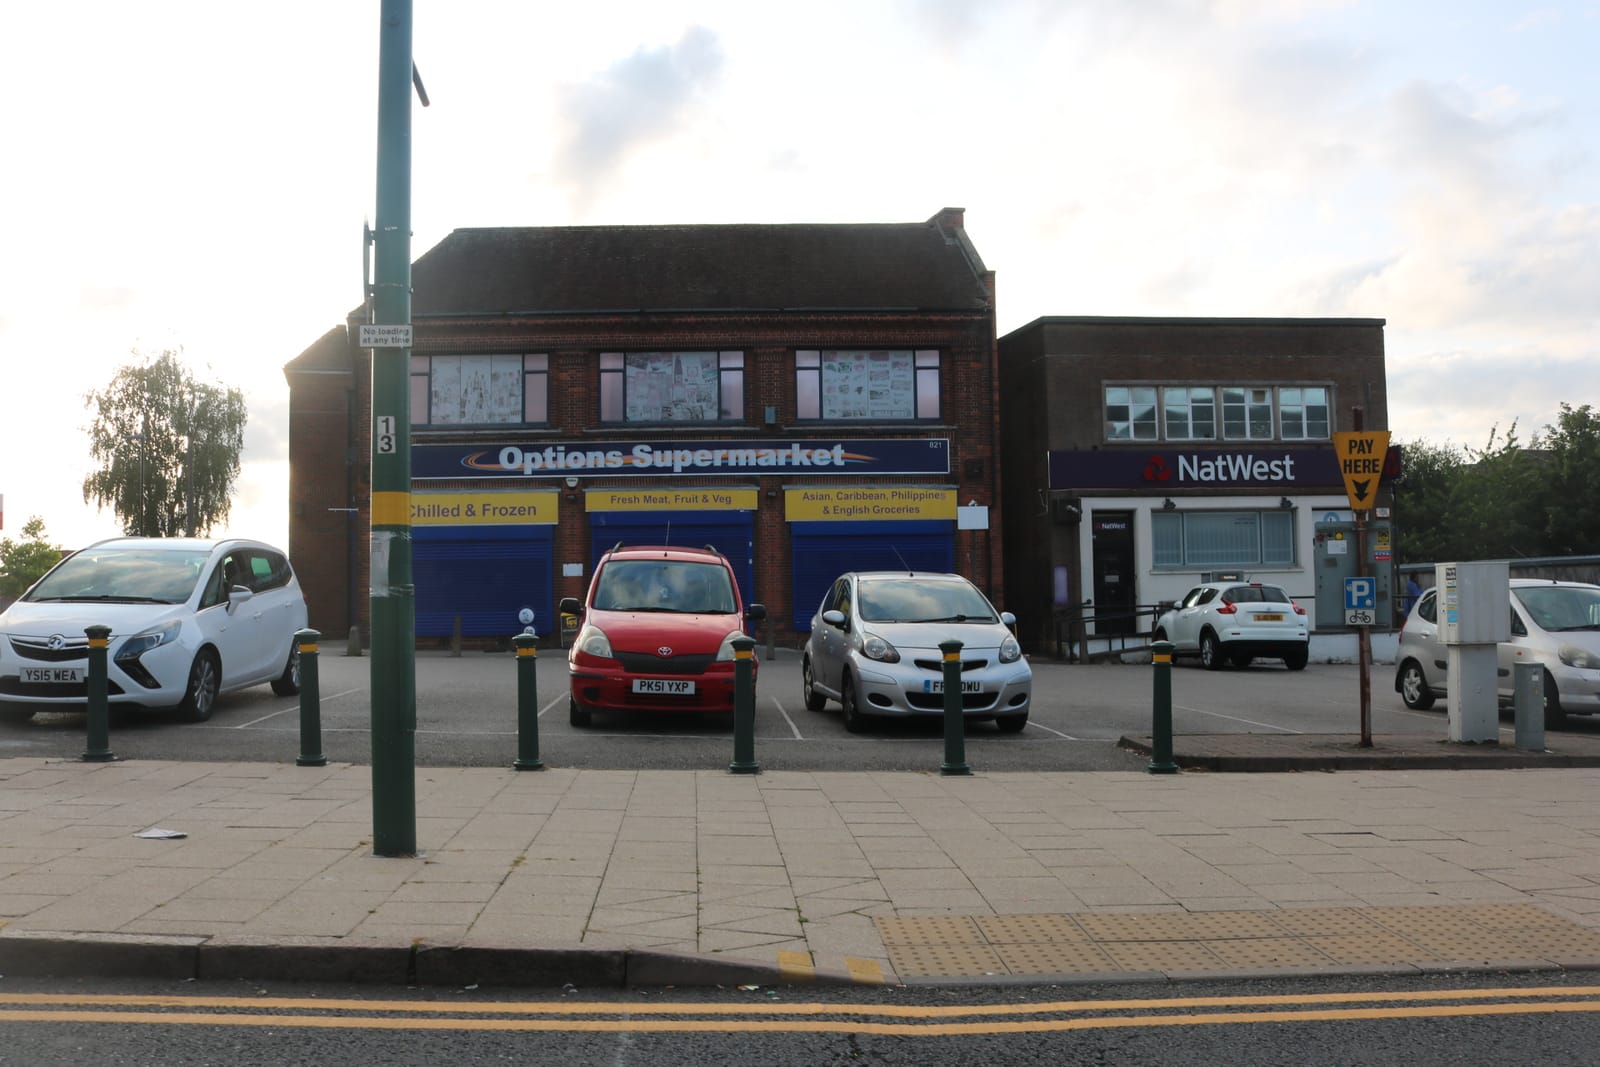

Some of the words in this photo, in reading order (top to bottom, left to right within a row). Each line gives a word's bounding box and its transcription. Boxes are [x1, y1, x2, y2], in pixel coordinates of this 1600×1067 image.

[363, 327, 375, 336] No
[378, 327, 409, 337] loading
[362, 336, 371, 344] at
[374, 337, 388, 345] any
[391, 336, 410, 344] time
[929, 440, 942, 449] 821
[1348, 439, 1374, 455] PAY
[498, 446, 624, 474] Options
[631, 443, 846, 473] Supermarket
[1178, 454, 1295, 481] NatWest
[1343, 458, 1380, 474] HERE
[610, 494, 641, 505] Fresh
[642, 494, 671, 506] Meat,
[674, 494, 699, 504] Fruit
[702, 494, 710, 504] &
[712, 493, 732, 506] Veg
[802, 491, 834, 502] Asian,
[836, 490, 889, 501] Caribbean,
[891, 490, 946, 502] Philippines
[465, 503, 477, 517] &
[482, 503, 537, 517] Frozen
[822, 505, 830, 515] &
[833, 504, 870, 517] English
[872, 504, 920, 515] Groceries
[1351, 580, 1370, 607] P
[26, 670, 51, 681] YS15
[54, 670, 77, 681] WEA
[639, 680, 665, 692] PK51
[667, 682, 689, 693] YXP
